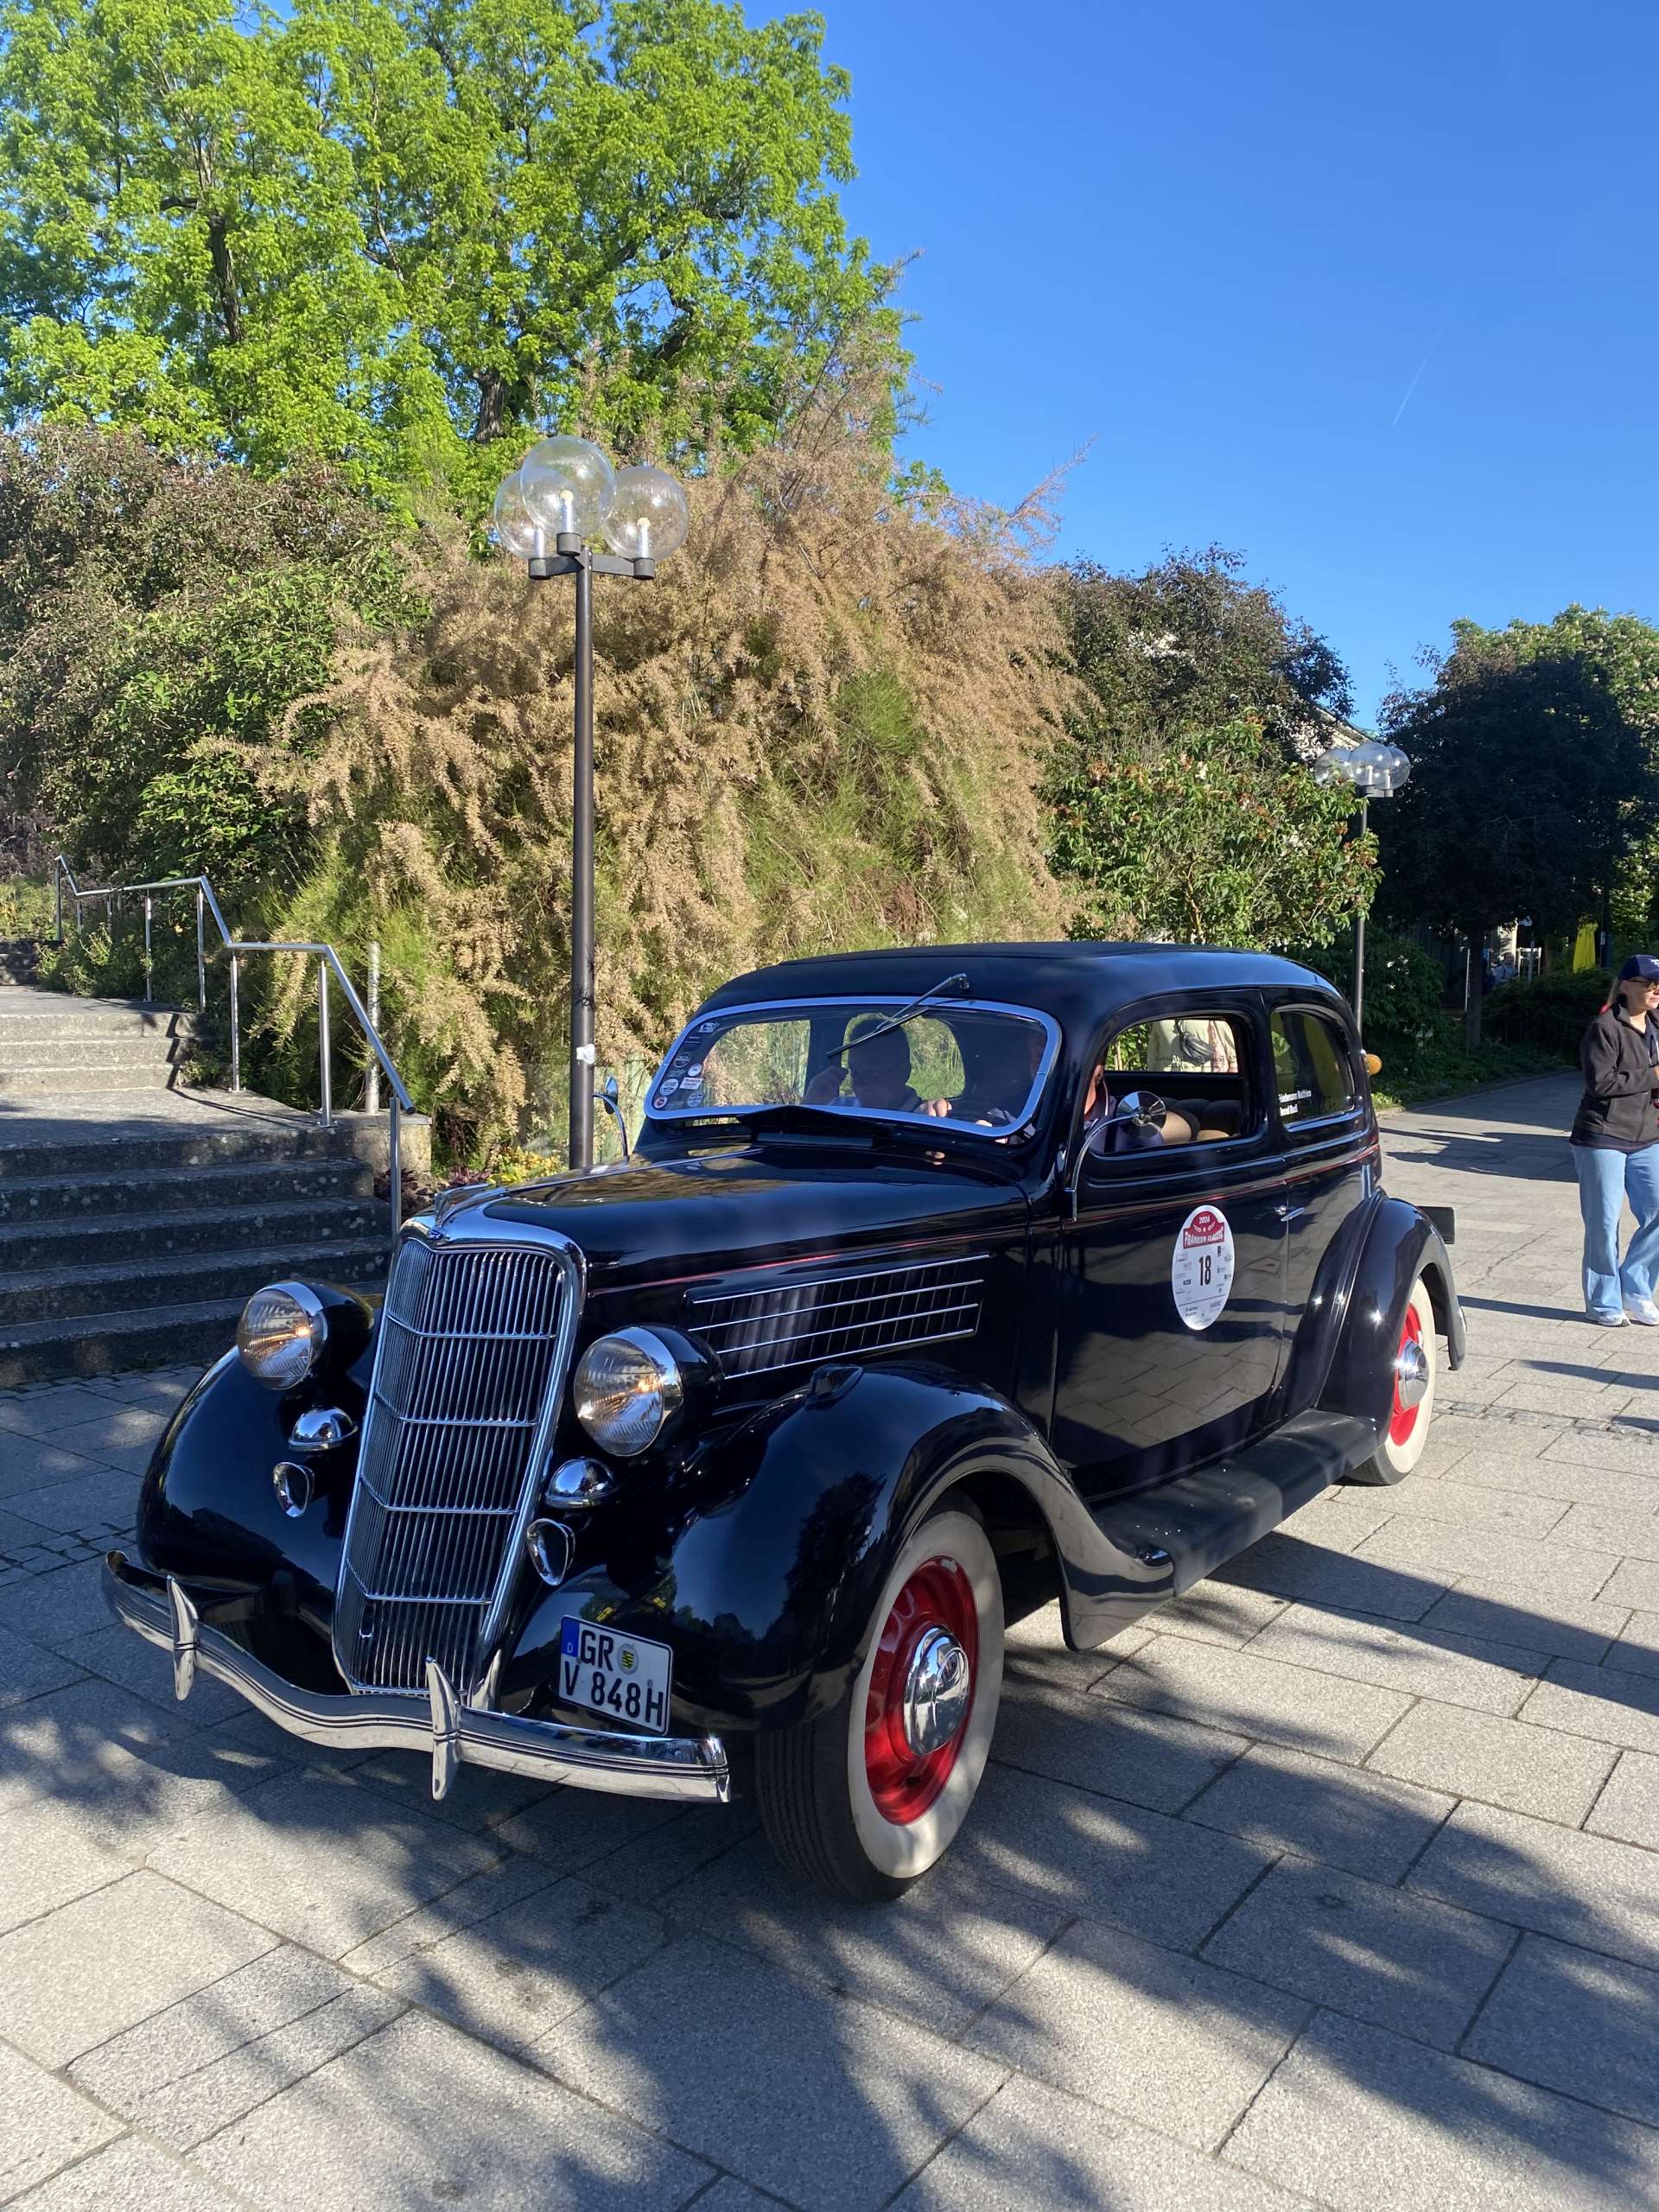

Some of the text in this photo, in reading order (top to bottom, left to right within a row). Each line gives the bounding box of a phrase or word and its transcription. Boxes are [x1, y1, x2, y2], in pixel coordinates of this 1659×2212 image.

[1198, 1255, 1211, 1286] 18
[567, 1643, 574, 1653] D
[581, 1630, 614, 1671] GR
[564, 1661, 664, 1726] V 848H
